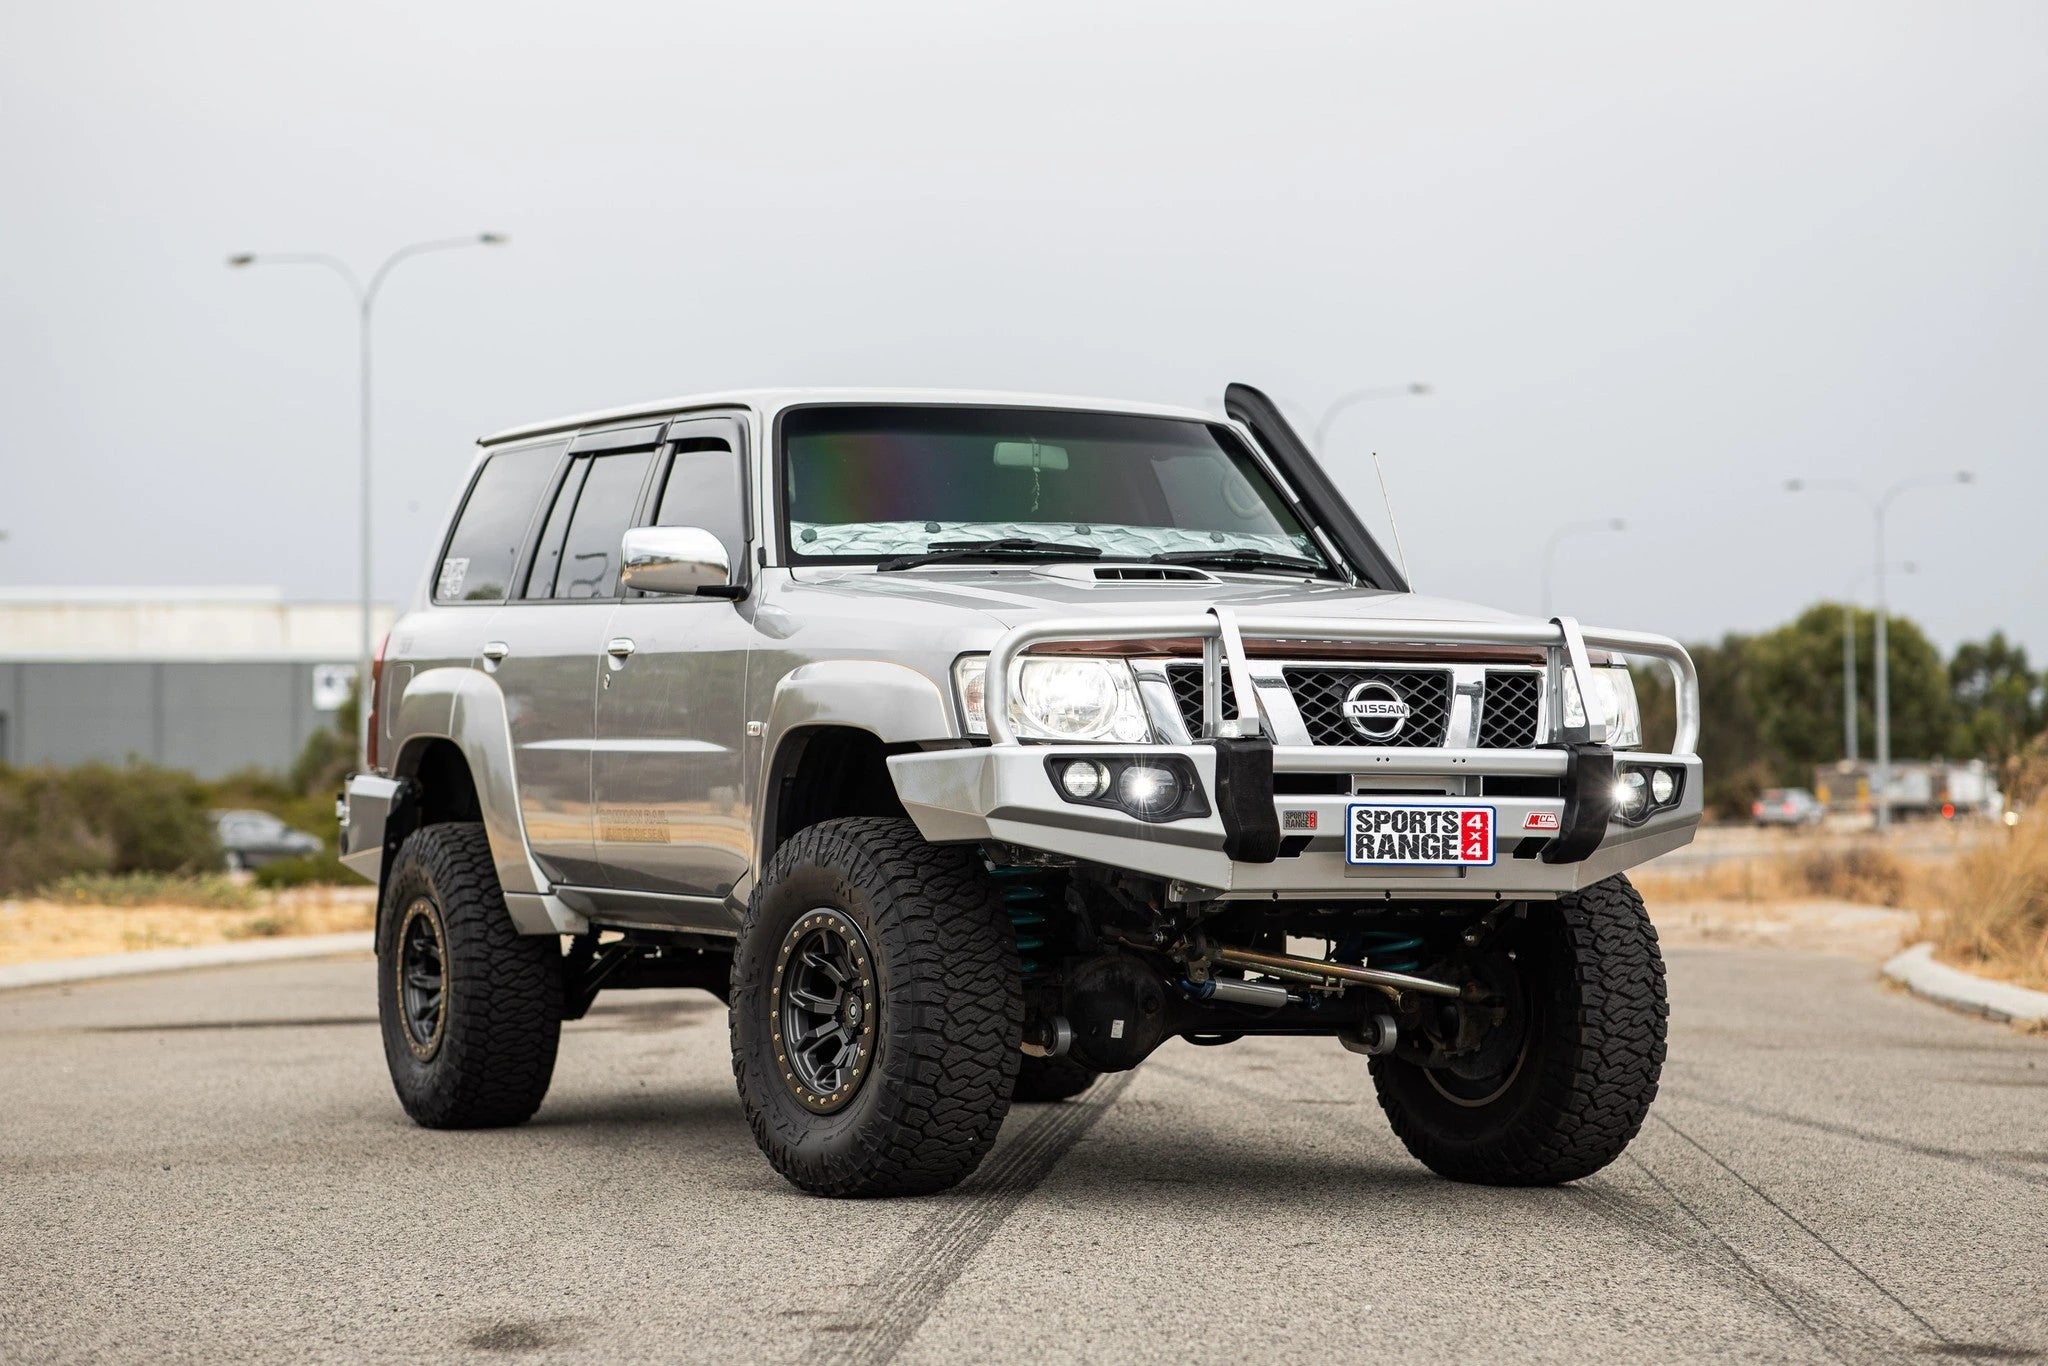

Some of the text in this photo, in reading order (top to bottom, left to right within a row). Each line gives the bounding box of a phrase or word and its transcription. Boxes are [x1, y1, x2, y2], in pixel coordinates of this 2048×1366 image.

[1352, 704, 1405, 714] NISSAN
[1285, 811, 1309, 820] SPORTS
[1285, 819, 1309, 828] RANGE
[1355, 809, 1459, 835] SPORTS
[1355, 833, 1459, 860] RANGE
